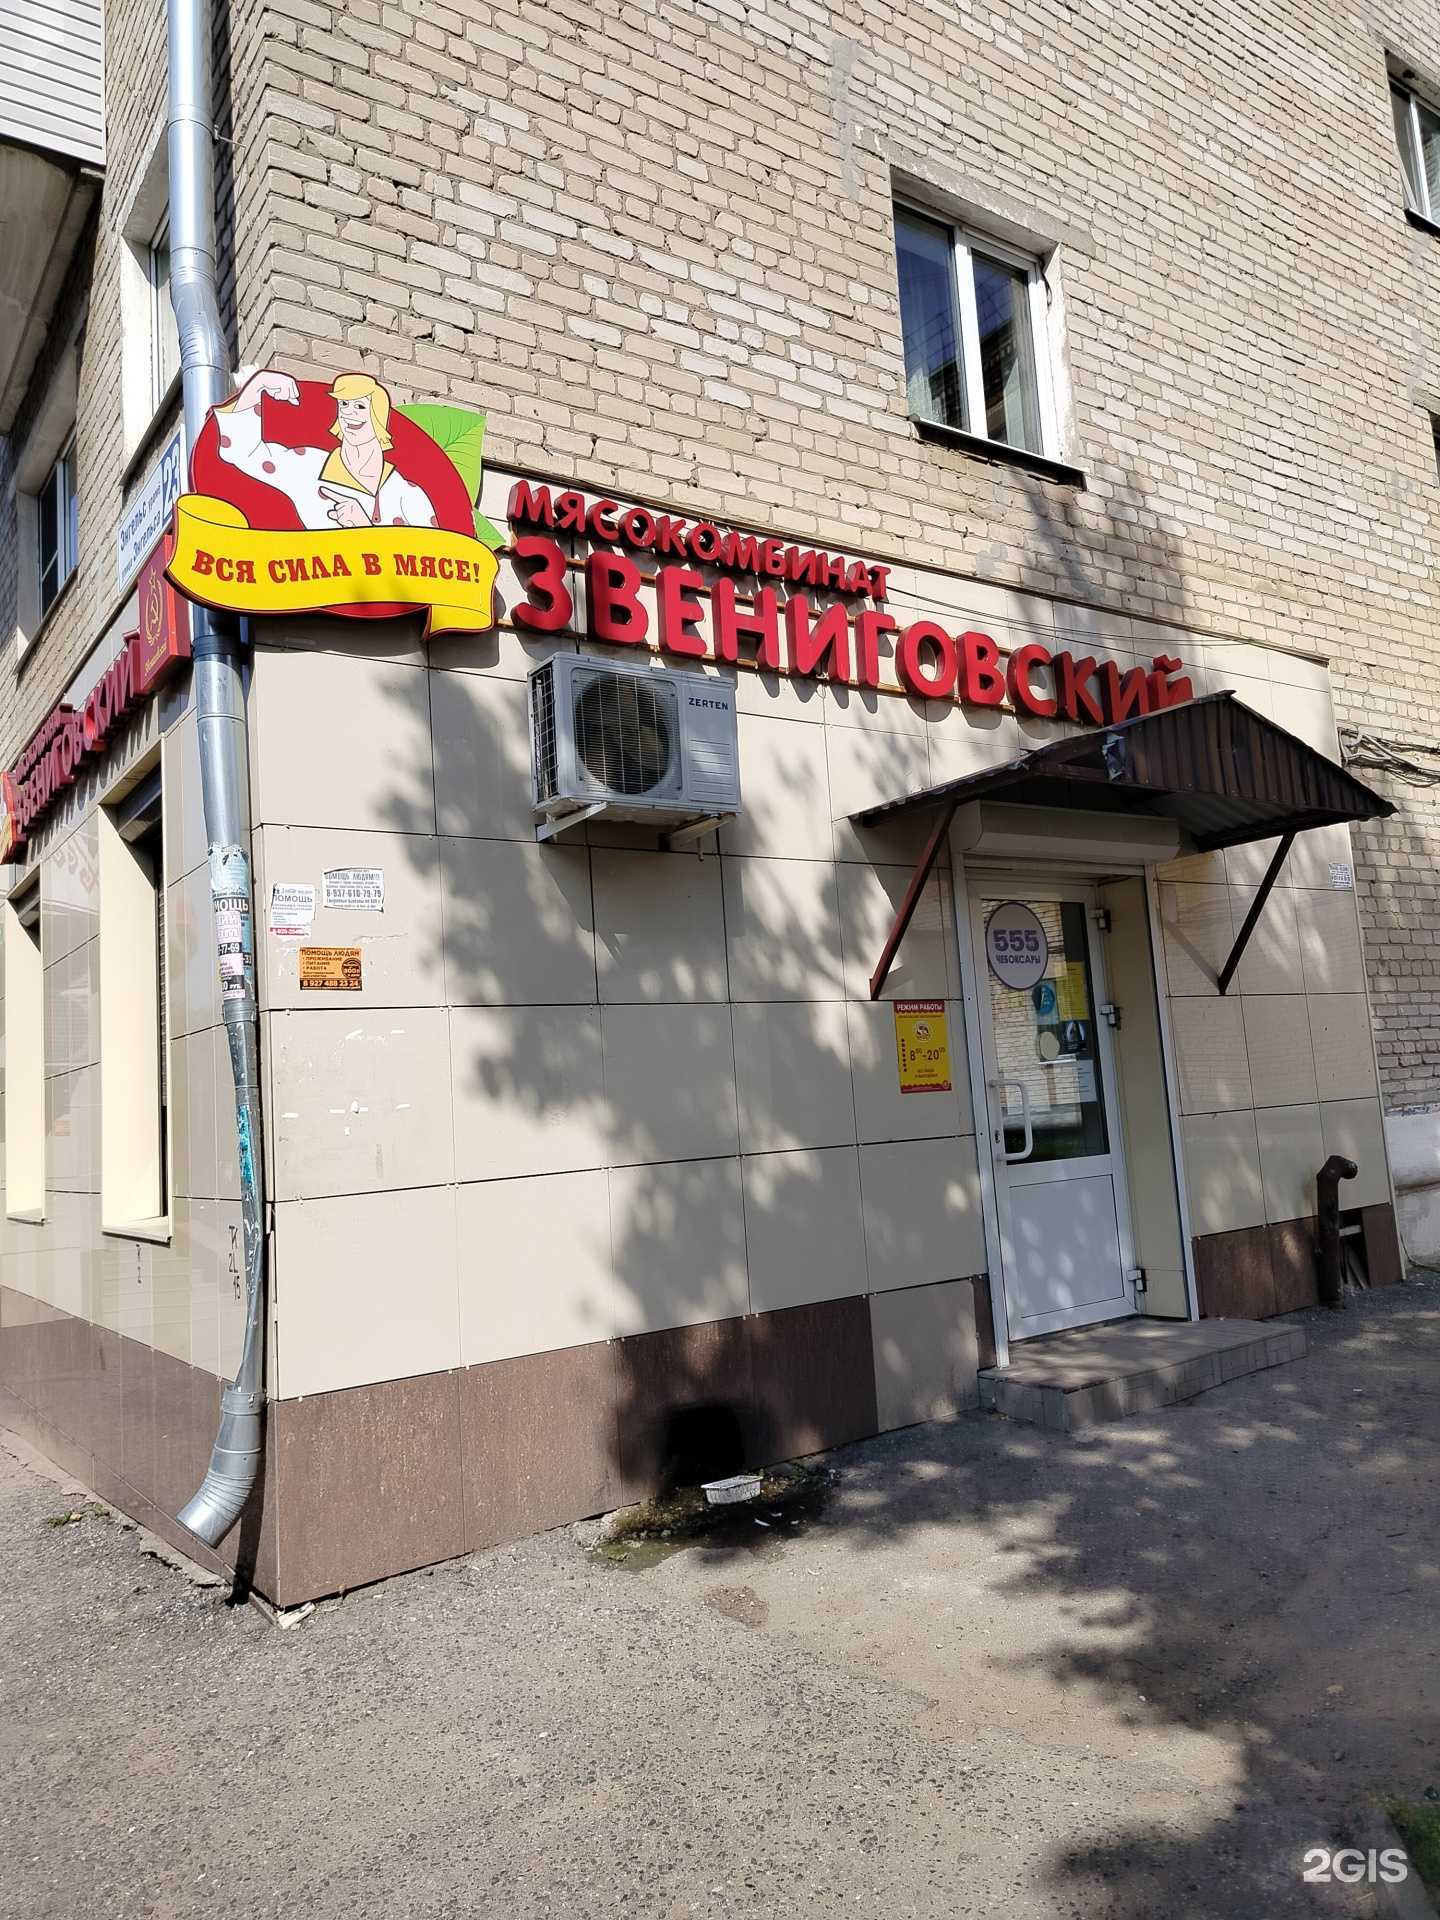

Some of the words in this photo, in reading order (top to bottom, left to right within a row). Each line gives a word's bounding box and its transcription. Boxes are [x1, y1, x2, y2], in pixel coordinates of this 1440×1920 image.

[508, 479, 892, 602] МЯСОКОМБИНАТ
[191, 549, 257, 584] ВСЯ
[267, 553, 353, 584] СИЛА
[361, 552, 383, 576] В
[393, 552, 481, 584] МЯСЕ!
[511, 535, 1195, 726] ЗВЕНИГОВСКИЙ
[688, 697, 729, 711] ZERTEN
[992, 929, 1040, 952] 555
